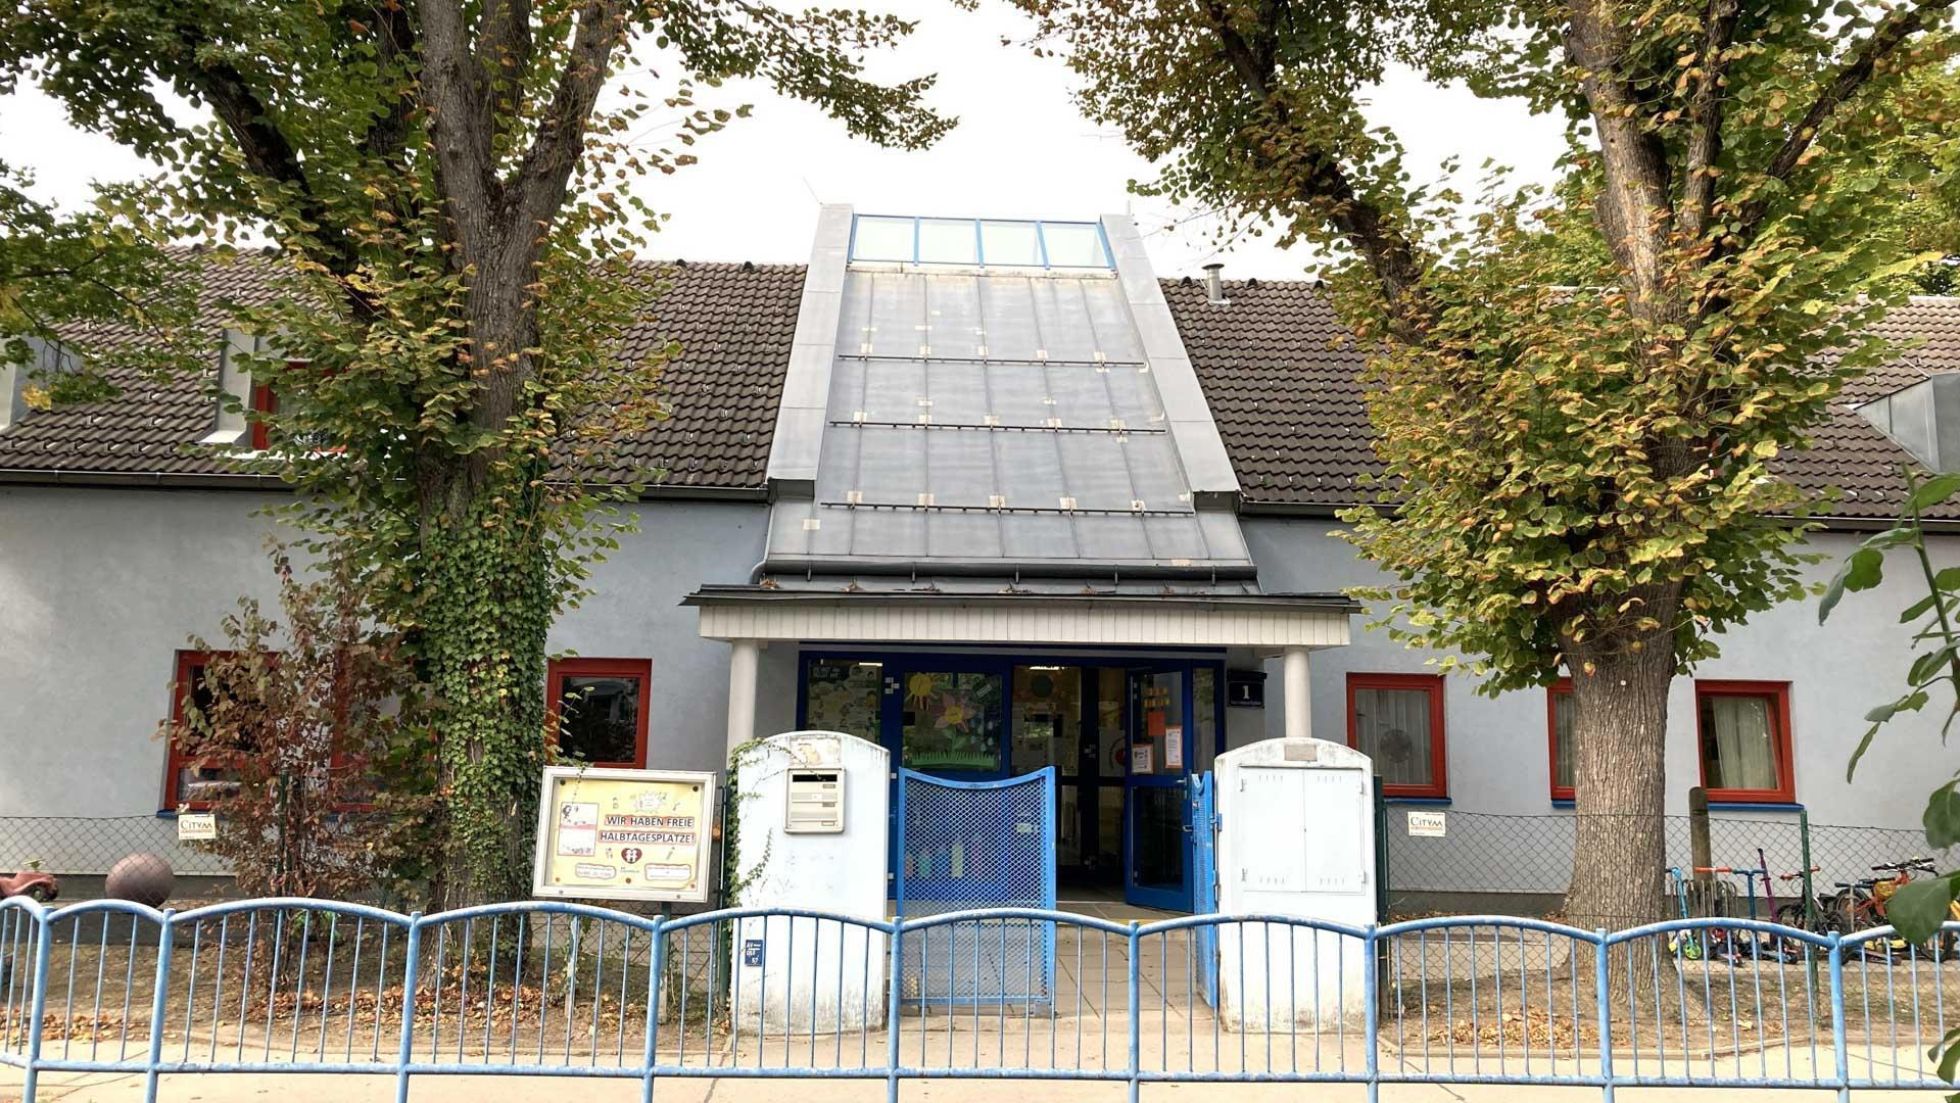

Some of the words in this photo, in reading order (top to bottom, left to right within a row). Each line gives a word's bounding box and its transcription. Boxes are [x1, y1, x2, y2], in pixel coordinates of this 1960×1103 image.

[1242, 685, 1250, 699] 1
[607, 815, 627, 825] WIR
[630, 817, 664, 826] HABEN
[667, 818, 693, 827] FREIE
